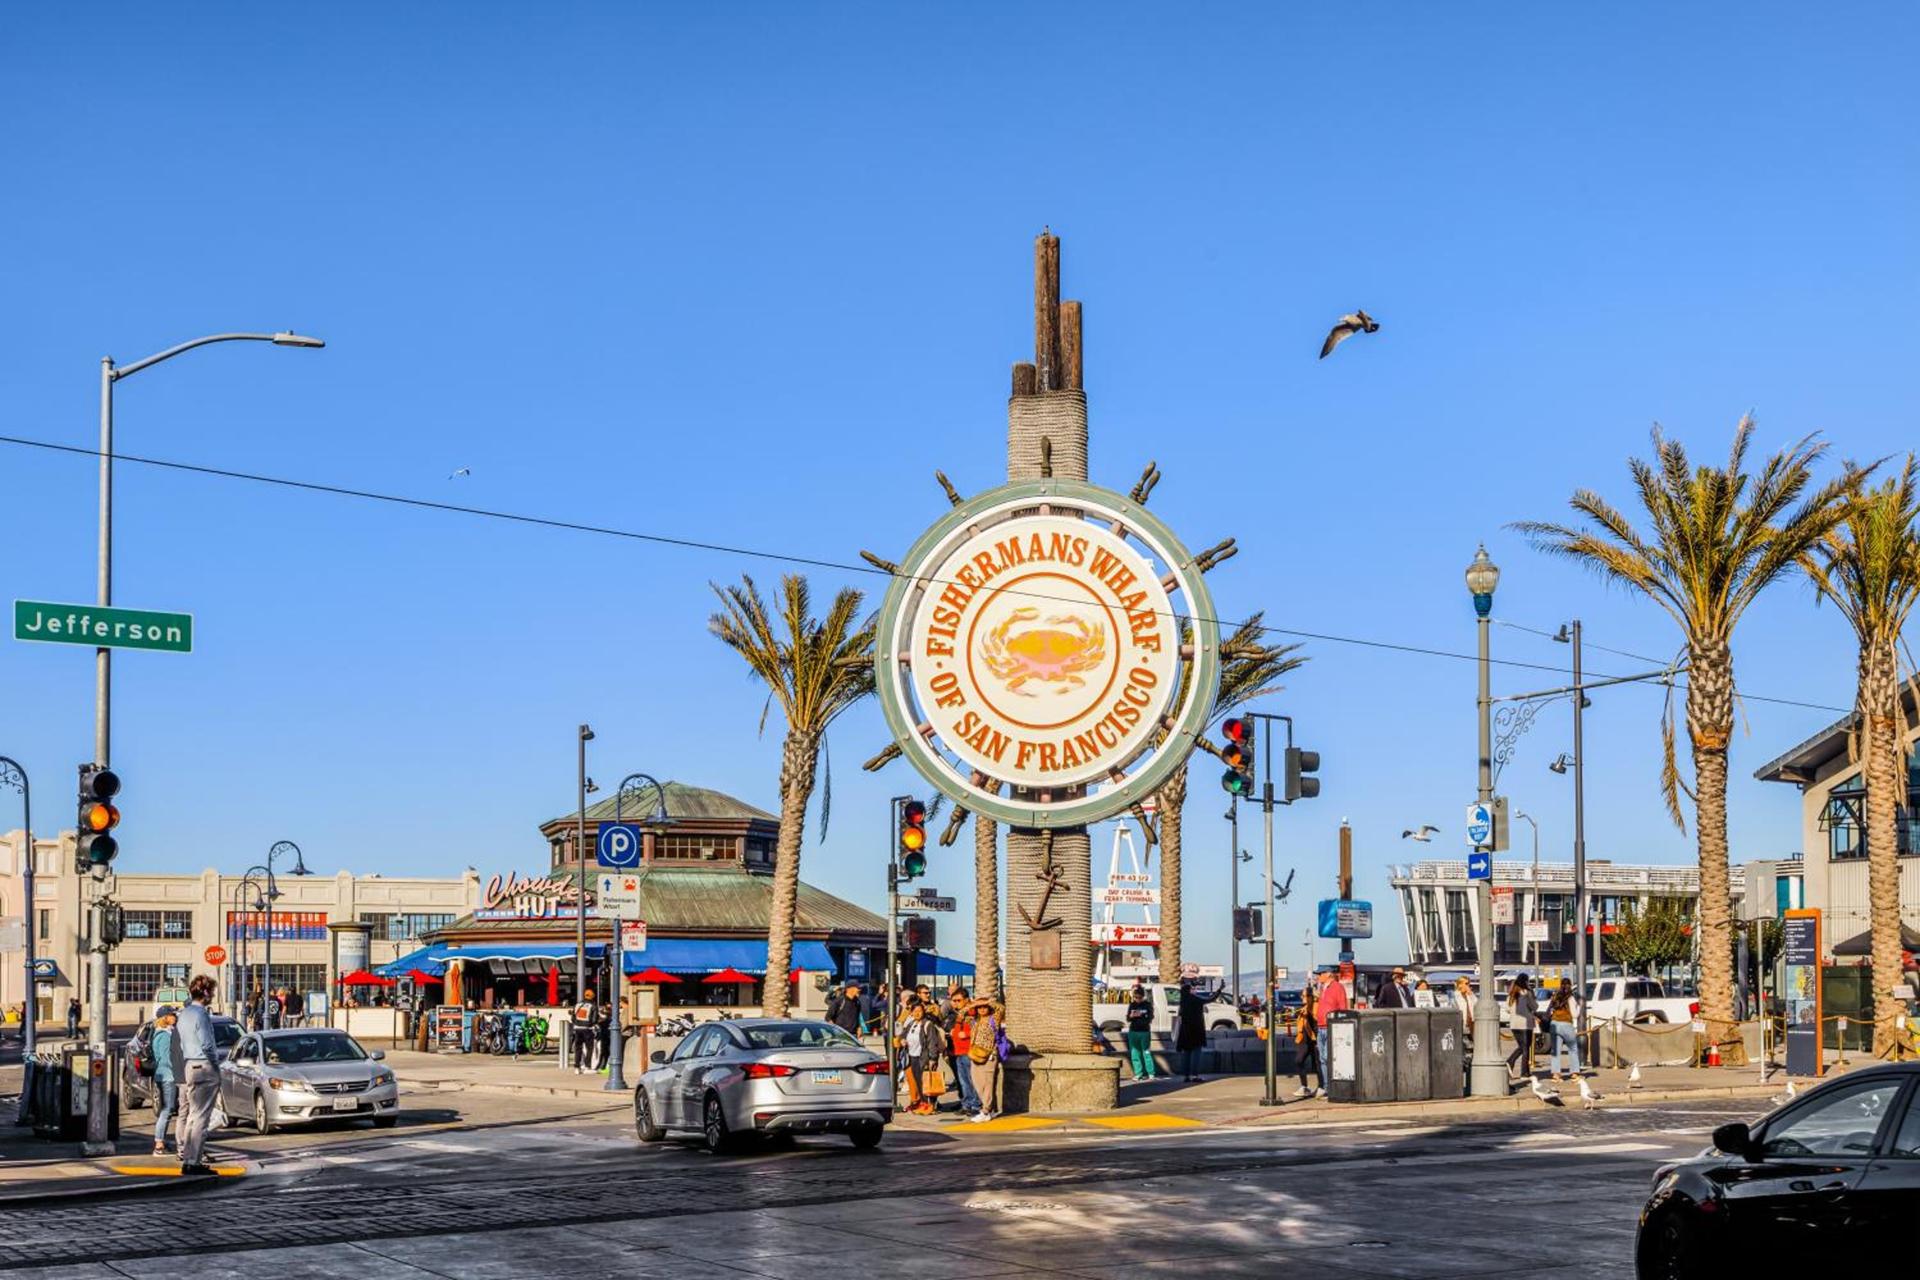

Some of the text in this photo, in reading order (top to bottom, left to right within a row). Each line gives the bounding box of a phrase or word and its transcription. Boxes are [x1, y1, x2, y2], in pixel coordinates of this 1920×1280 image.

[926, 532, 1161, 659] FISHERMANS WHARF
[25, 611, 182, 643] Jefferson
[929, 667, 1158, 773] OF SAN FRANCISCO
[514, 895, 561, 917] HUT
[904, 898, 951, 909] Jefferson
[206, 950, 225, 961] STOP
